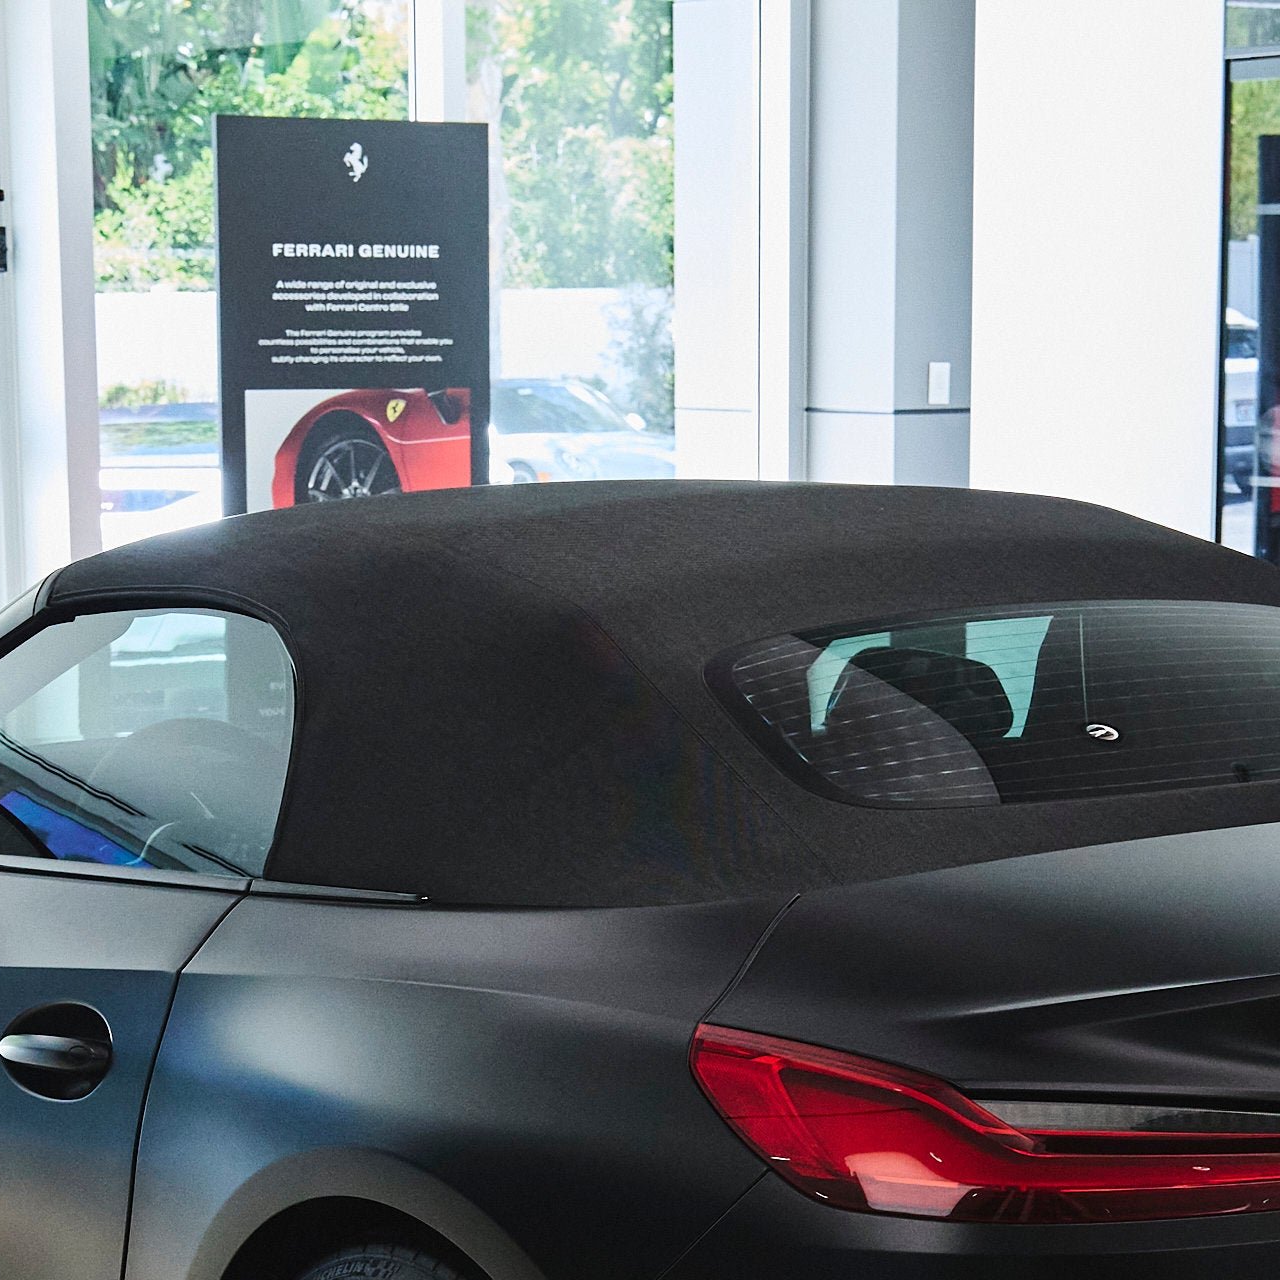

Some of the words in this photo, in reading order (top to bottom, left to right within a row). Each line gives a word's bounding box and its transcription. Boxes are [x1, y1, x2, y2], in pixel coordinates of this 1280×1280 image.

[271, 243, 354, 257] FERRARI
[358, 244, 440, 258] GENUINE
[276, 280, 284, 289] A
[284, 280, 306, 289] wide
[307, 281, 334, 290] range
[334, 280, 345, 289] of
[345, 280, 378, 290] original
[379, 281, 396, 289] and
[373, 292, 382, 300] in
[305, 303, 325, 312] with
[326, 303, 358, 312] Ferrari
[358, 303, 389, 312] Centro
